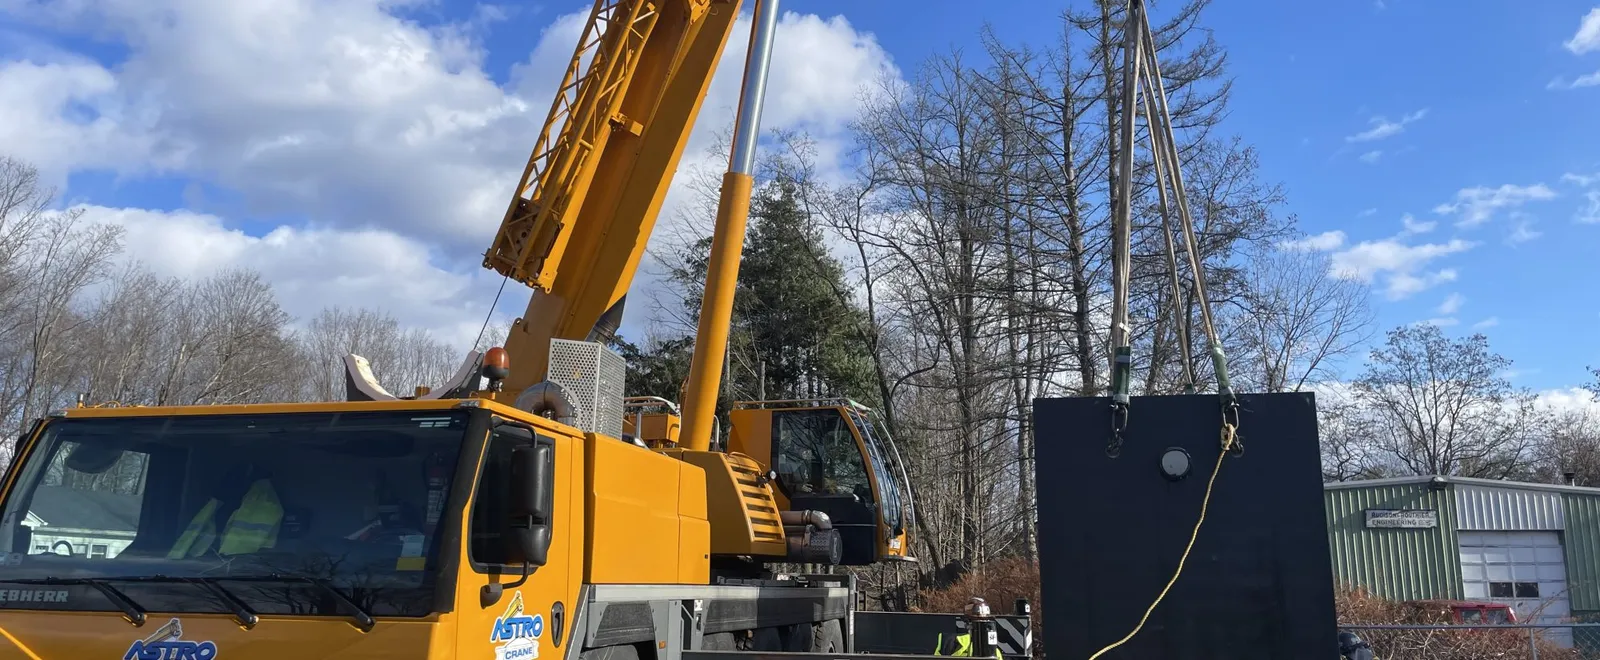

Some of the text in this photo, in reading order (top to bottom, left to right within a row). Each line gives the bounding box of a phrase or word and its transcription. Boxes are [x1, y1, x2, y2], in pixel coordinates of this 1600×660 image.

[491, 616, 543, 641] ASTRO
[124, 640, 216, 660] ASTRO
[505, 647, 533, 660] CRANE
